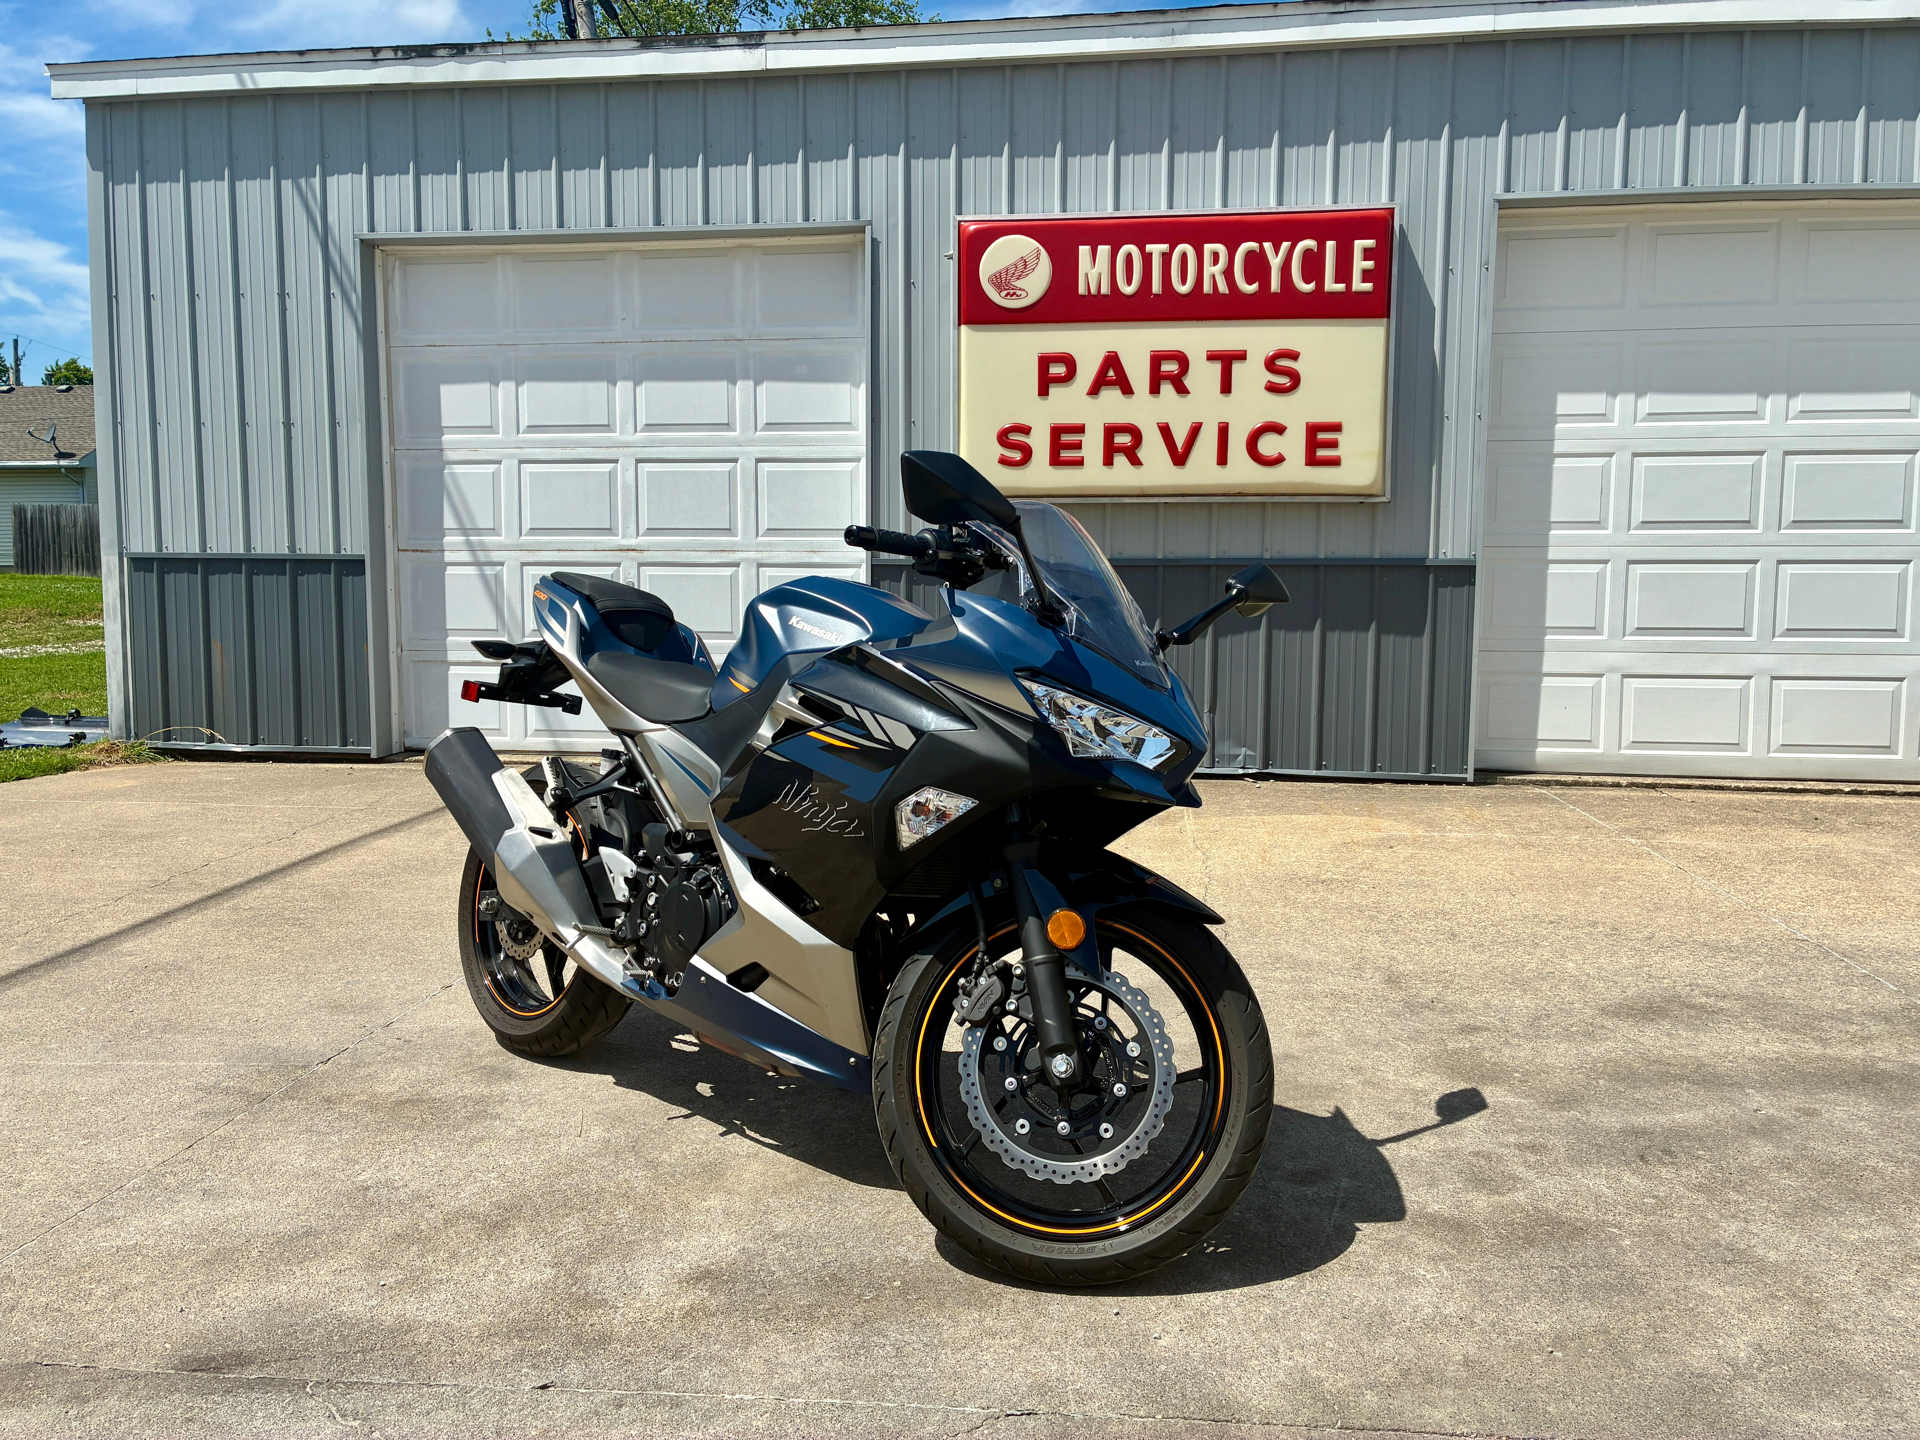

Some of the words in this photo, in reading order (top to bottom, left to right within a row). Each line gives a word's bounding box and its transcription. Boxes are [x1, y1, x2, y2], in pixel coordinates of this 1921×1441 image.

[1078, 239, 1377, 296] MOTORCYCLE
[1037, 348, 1302, 397] PARTS
[996, 420, 1344, 467] SERVICE
[788, 615, 844, 644] Kawasaki
[772, 778, 865, 837] Ninja
